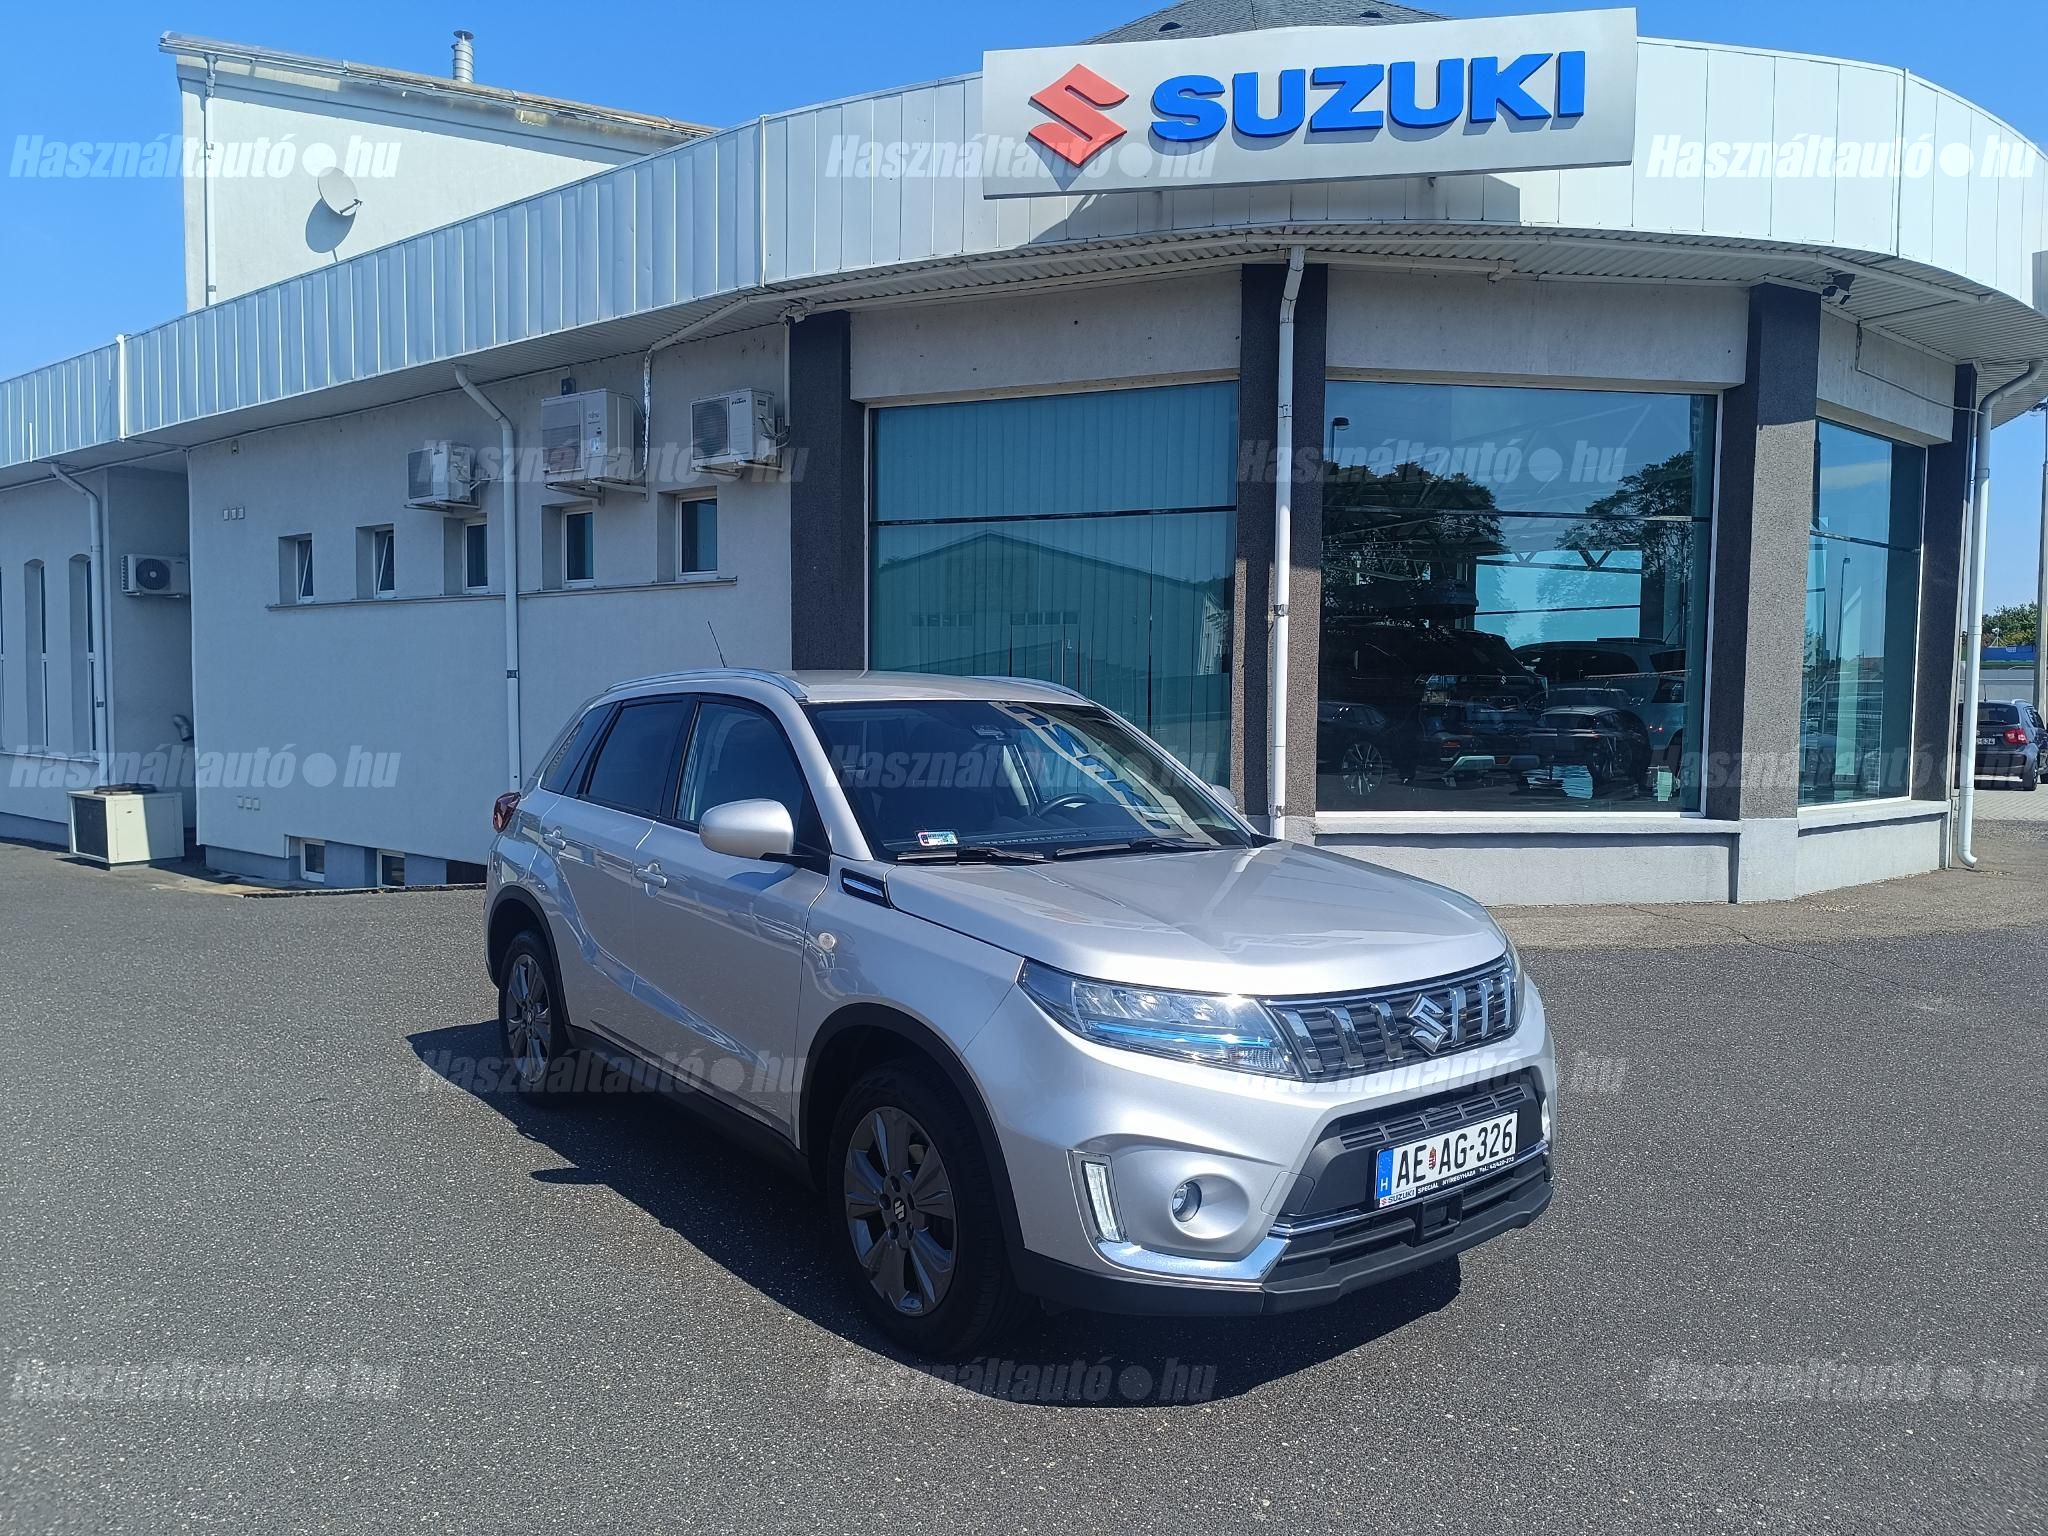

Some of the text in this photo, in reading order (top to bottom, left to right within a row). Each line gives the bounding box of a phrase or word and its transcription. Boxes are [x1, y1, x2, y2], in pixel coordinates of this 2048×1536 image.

[1151, 50, 1585, 142] SUZUKI
[1396, 1118, 1513, 1189] AE AG-326
[1380, 1177, 1389, 1192] H
[1388, 1189, 1415, 1204] SUZUKI
[1417, 1182, 1439, 1194] SPECIAL
